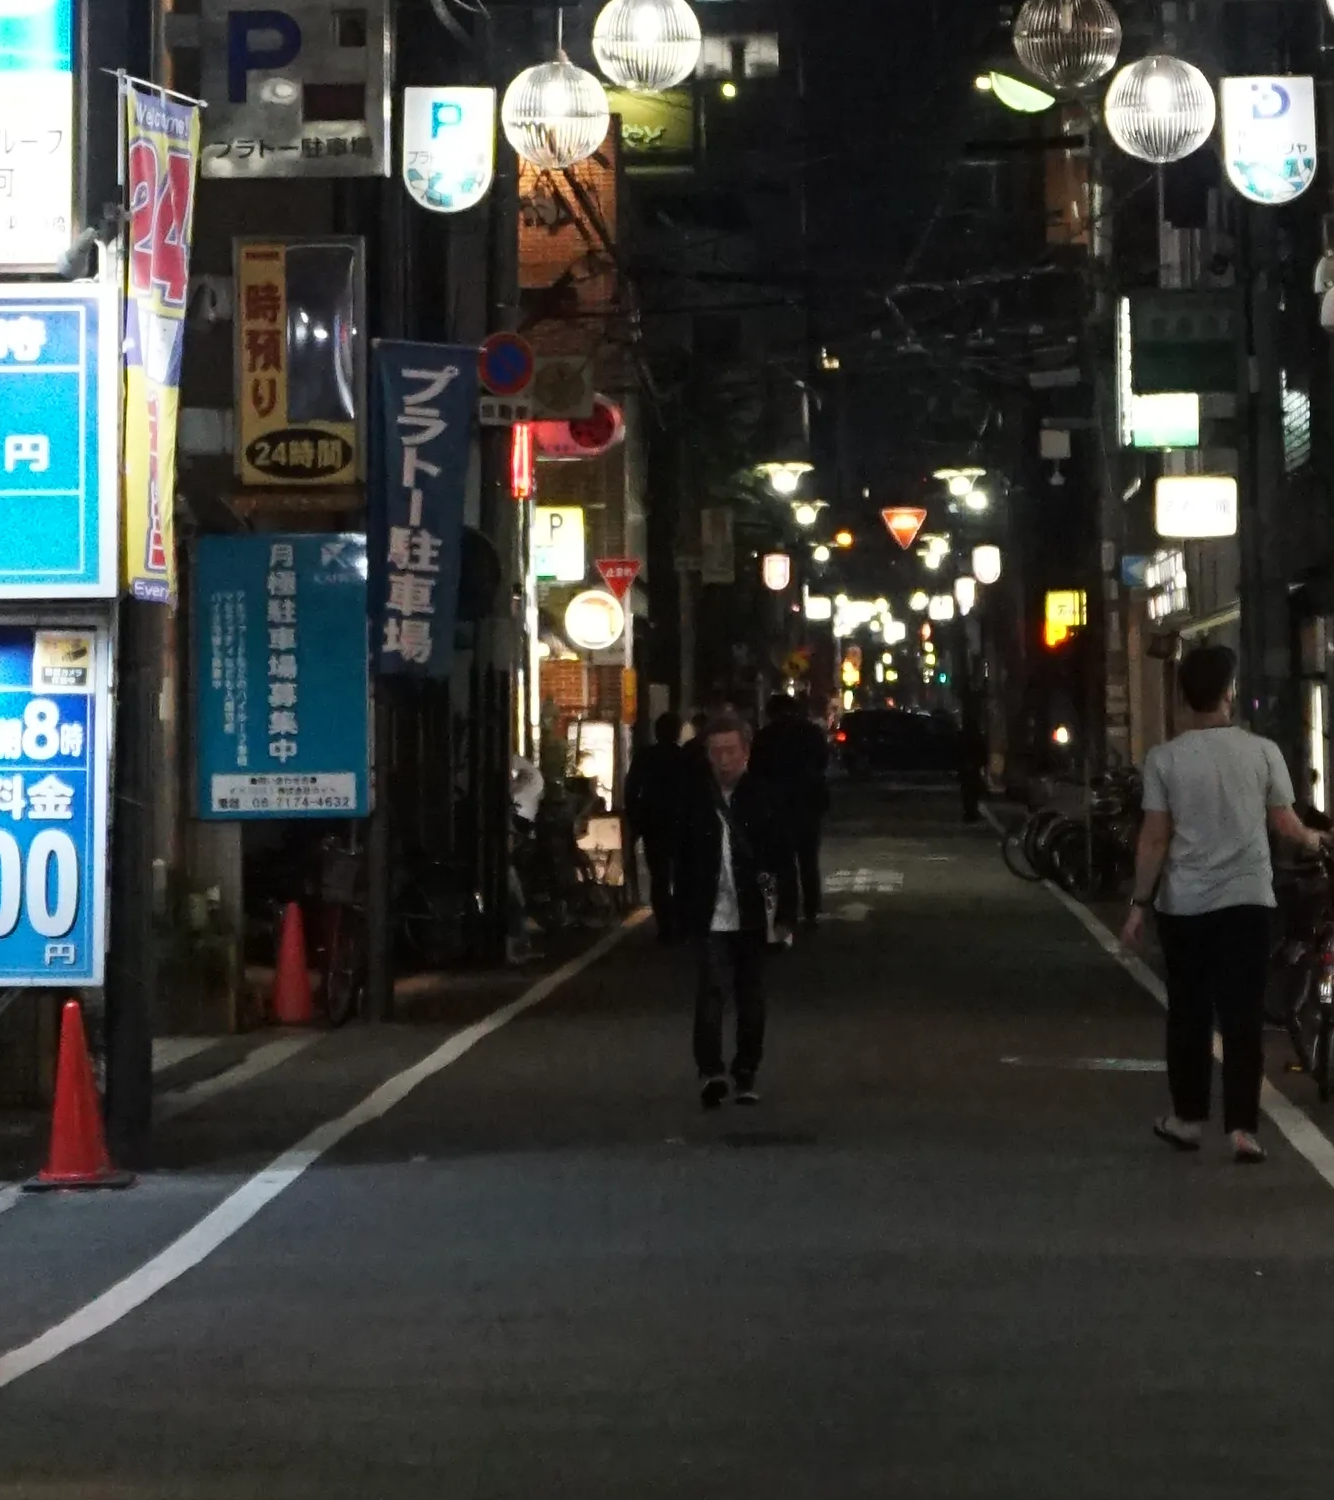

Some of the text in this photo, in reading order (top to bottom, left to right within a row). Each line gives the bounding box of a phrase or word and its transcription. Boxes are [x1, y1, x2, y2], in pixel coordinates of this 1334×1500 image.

[229, 10, 302, 103] P
[431, 102, 463, 139] P
[130, 139, 192, 304] 24
[253, 438, 343, 470] 24時間
[383, 366, 458, 664] プラトー駐車場
[549, 513, 563, 541] P
[277, 796, 350, 808] 7174-4632
[45, 944, 76, 966] 円
